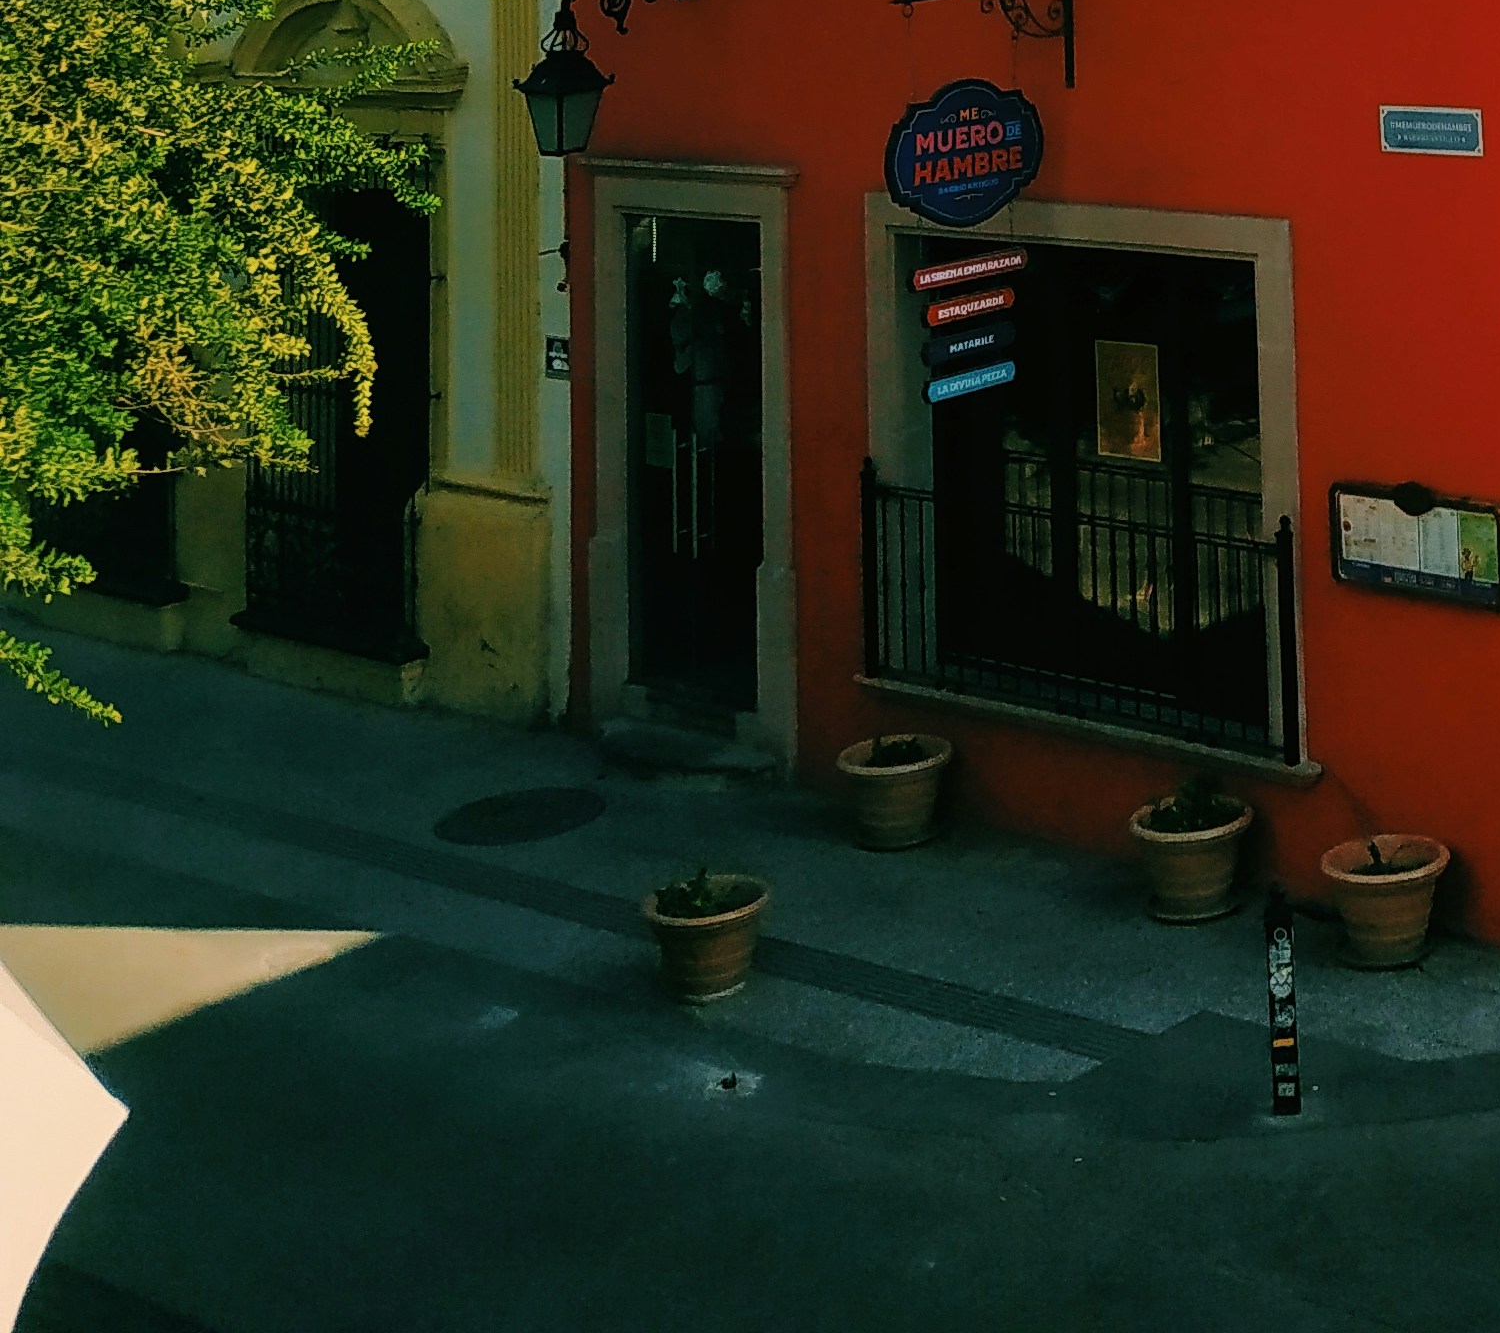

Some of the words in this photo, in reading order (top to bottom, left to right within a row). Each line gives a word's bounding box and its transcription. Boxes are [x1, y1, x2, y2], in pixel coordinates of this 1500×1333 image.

[960, 107, 980, 122] ME
[915, 120, 1004, 156] MUERO
[1005, 122, 1022, 138] DE
[914, 145, 1023, 187] HAMBRE
[919, 274, 931, 285] LA
[931, 266, 963, 282] SIRENA
[963, 254, 1022, 276] EMBARAZADA
[937, 295, 1005, 320] ESTAQUEARDE
[949, 334, 995, 354] MATARILE
[937, 383, 949, 395] LA
[949, 375, 981, 392] DIVINA
[981, 368, 1008, 383] PIZZA
